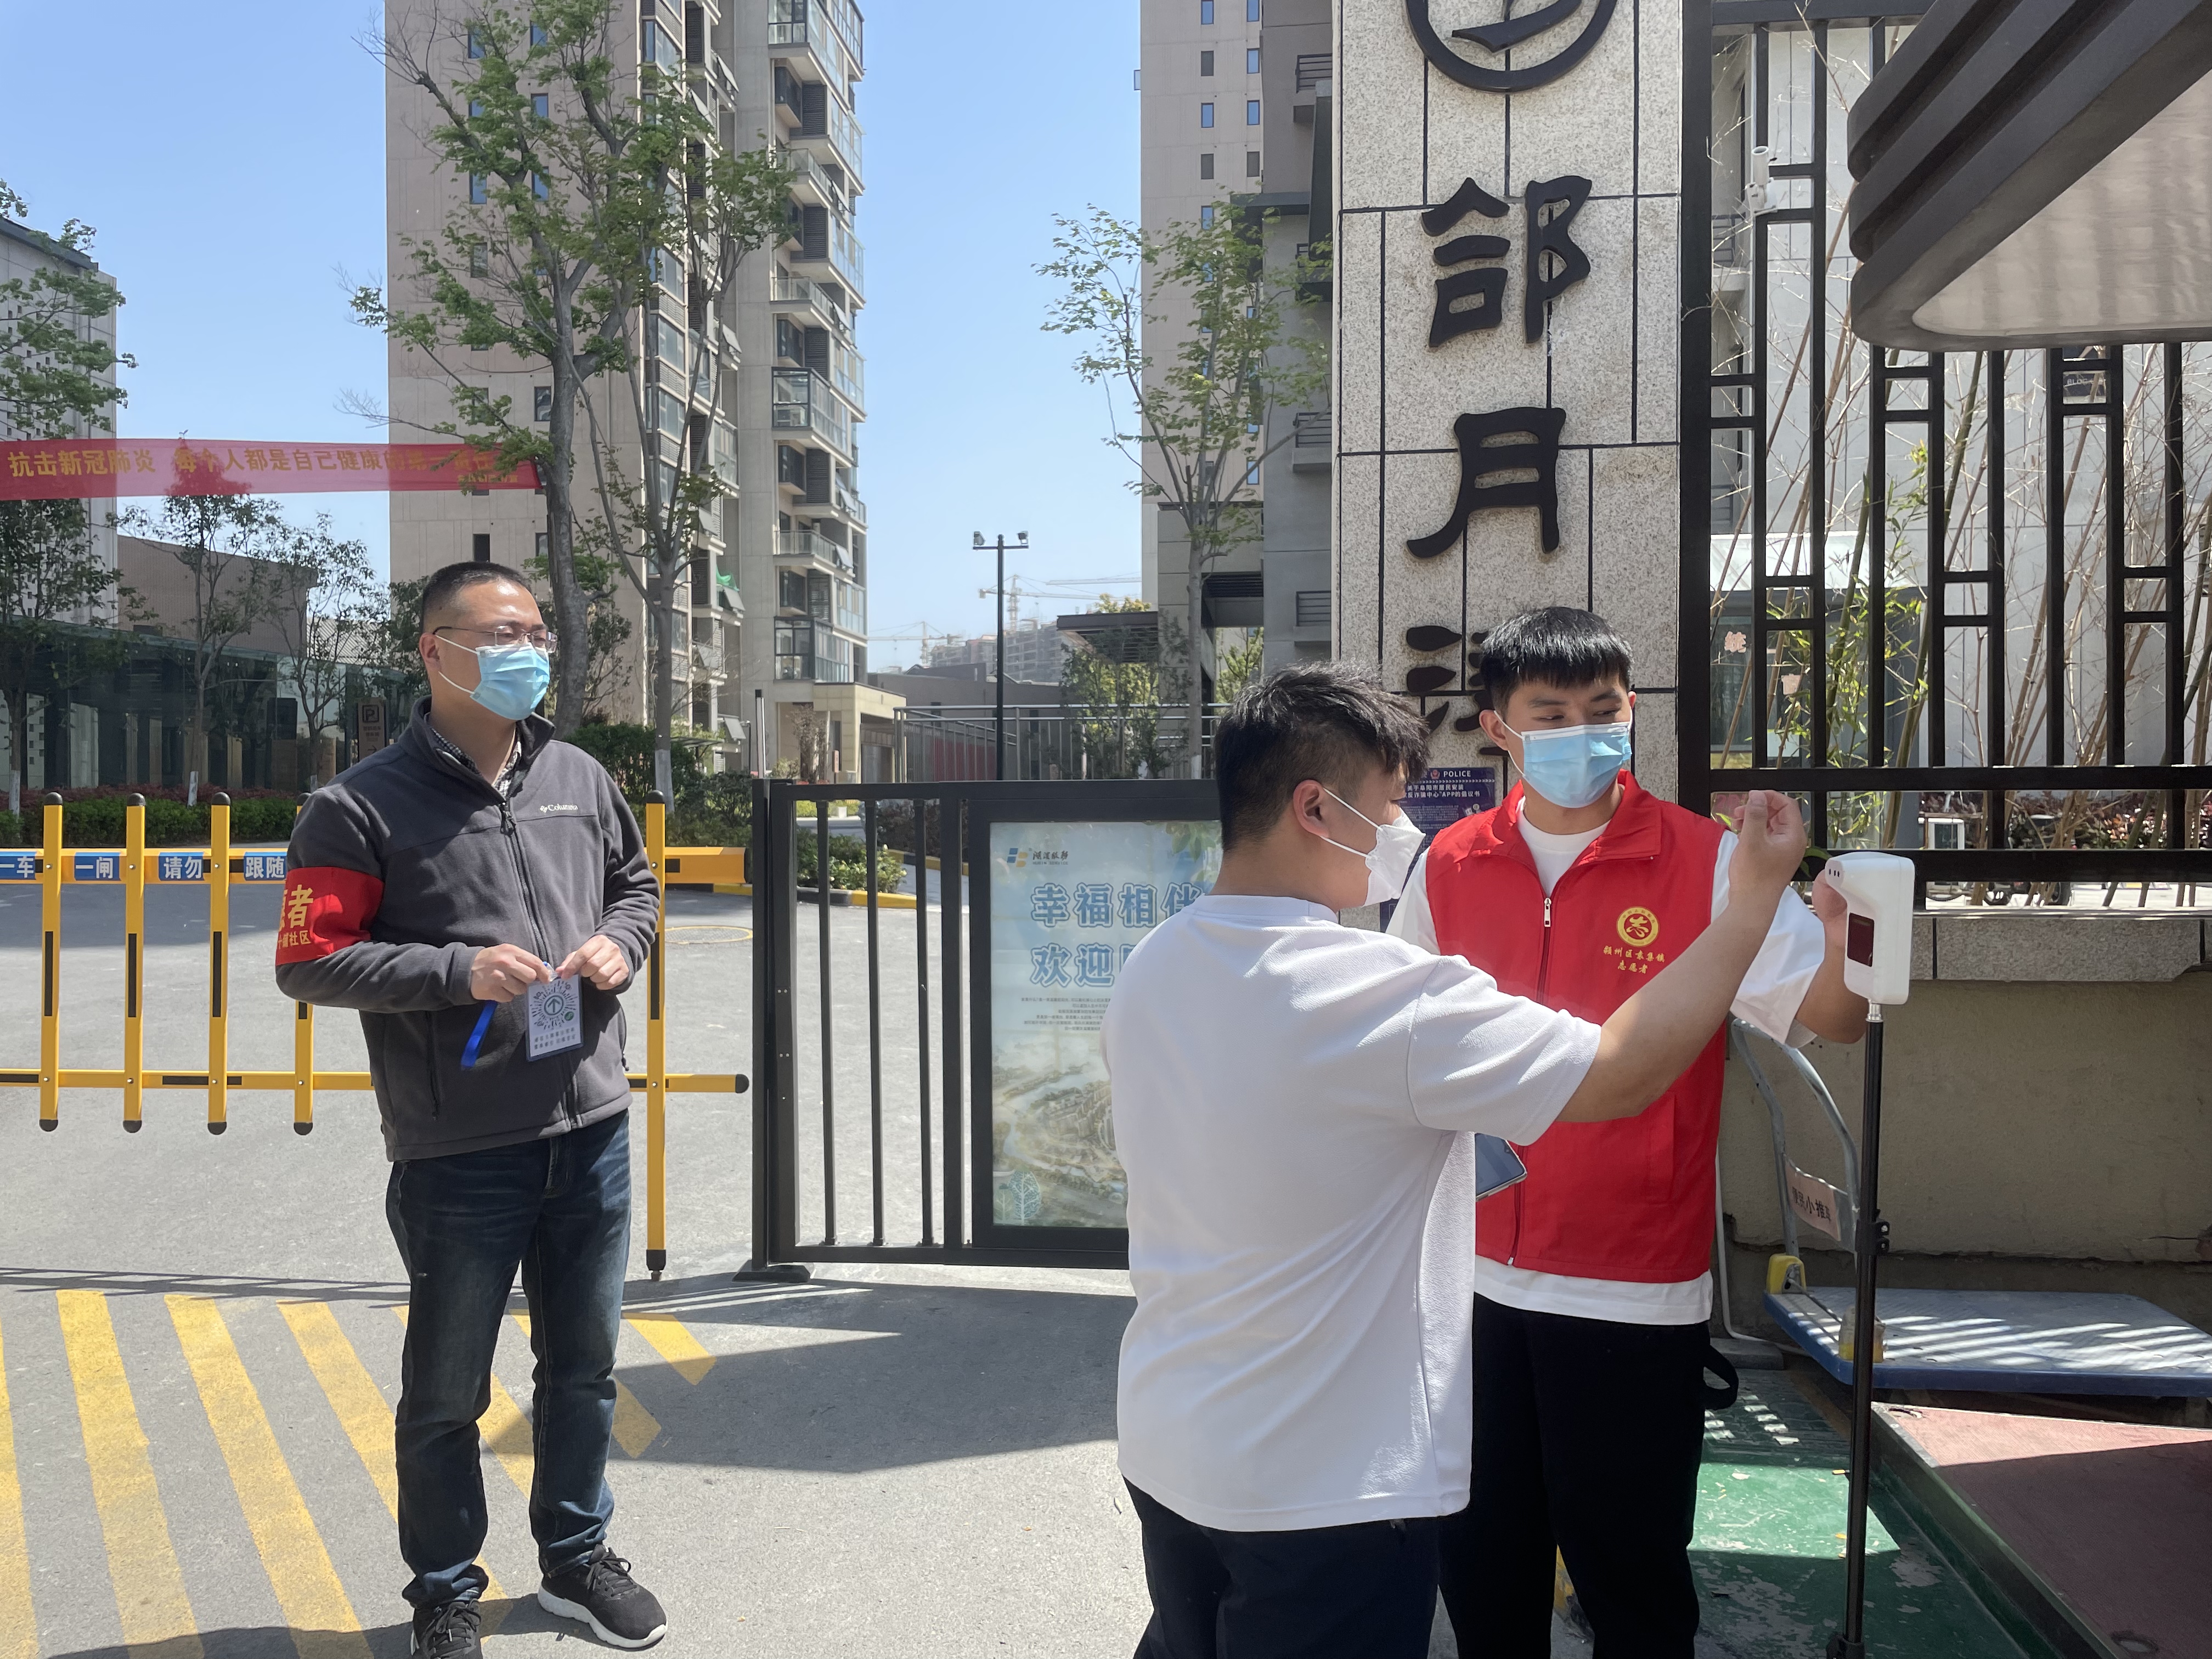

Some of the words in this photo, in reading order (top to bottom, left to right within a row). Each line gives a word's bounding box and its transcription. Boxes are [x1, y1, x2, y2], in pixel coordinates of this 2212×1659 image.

[8, 449, 155, 477] 抗击新冠肺炎
[548, 803, 578, 811] Columbia
[76, 857, 114, 879] 一闸
[164, 856, 202, 879] 请勿
[246, 856, 285, 879] 跟随
[1618, 960, 1648, 974] 志愿者
